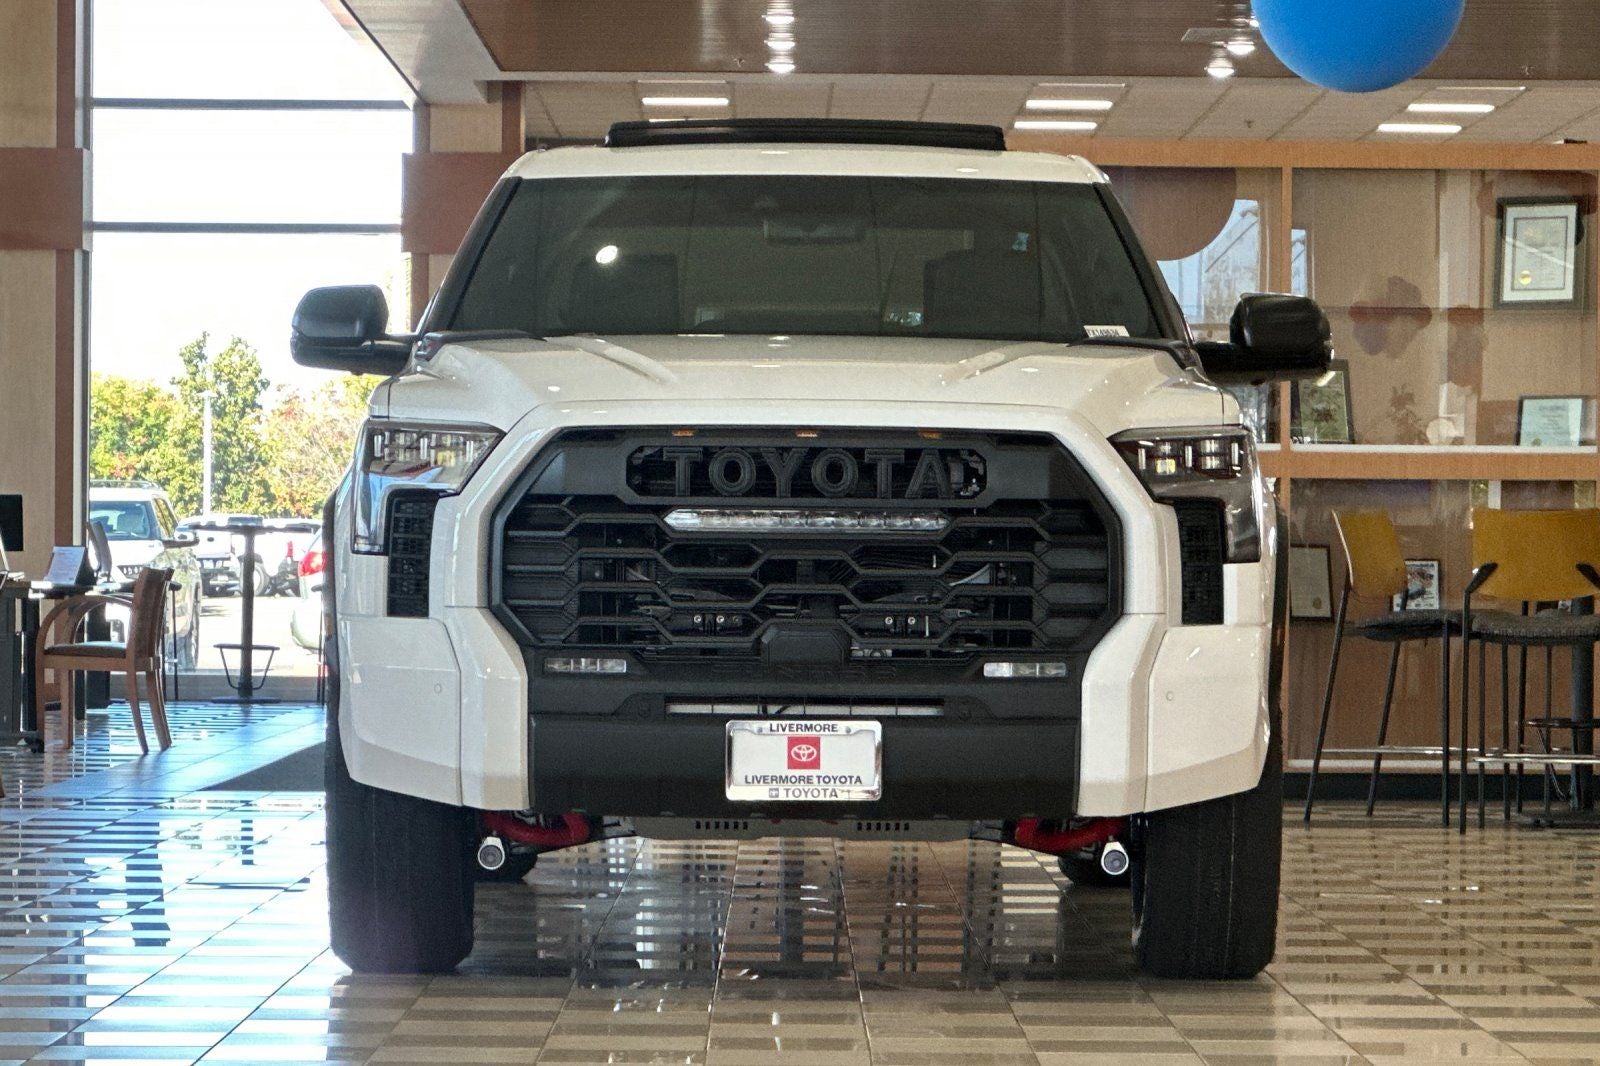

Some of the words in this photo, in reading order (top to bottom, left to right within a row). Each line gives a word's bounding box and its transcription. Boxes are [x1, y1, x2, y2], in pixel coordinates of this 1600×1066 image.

[662, 447, 953, 499] TOYOTA
[769, 723, 838, 733] LIVERMORE
[744, 775, 814, 785] LIVERMORE
[816, 775, 863, 785] TOYOTA
[783, 787, 838, 799] TOYOTA
